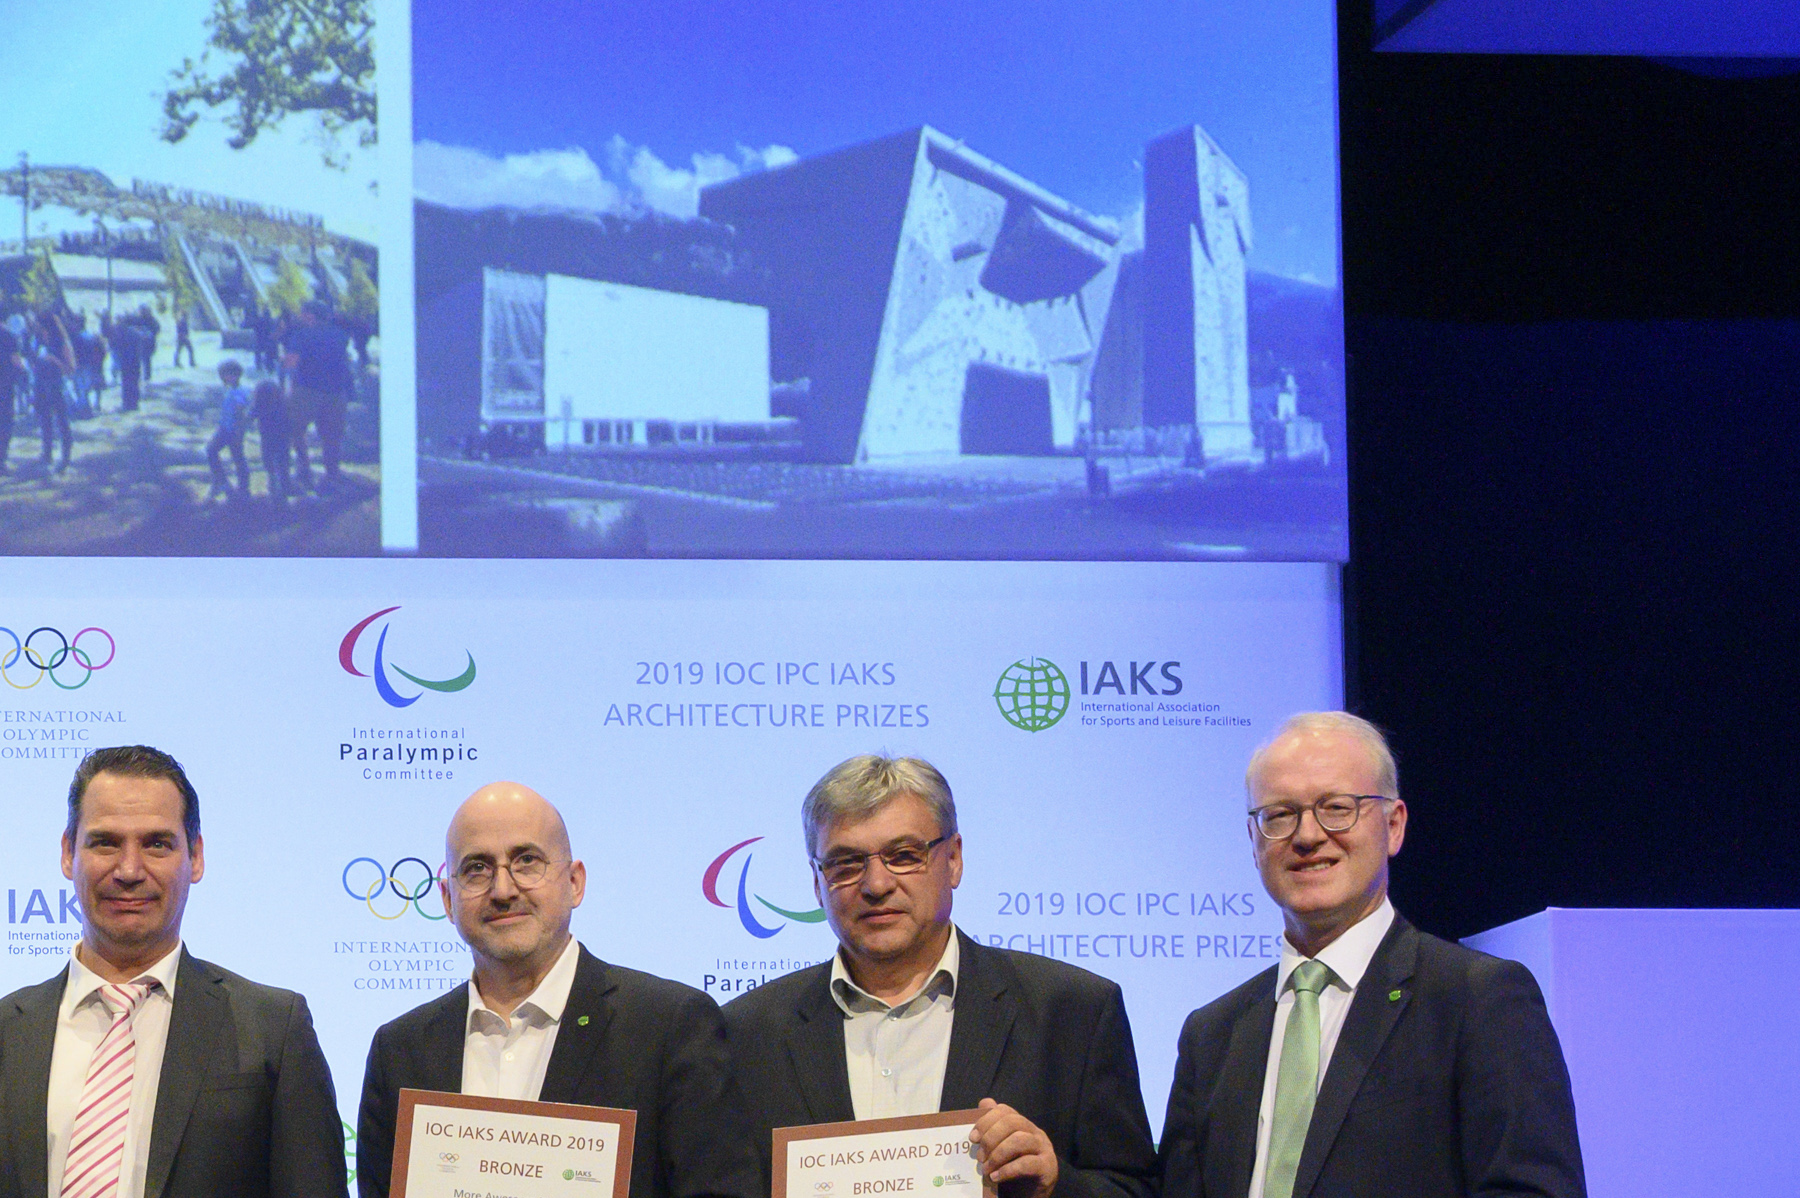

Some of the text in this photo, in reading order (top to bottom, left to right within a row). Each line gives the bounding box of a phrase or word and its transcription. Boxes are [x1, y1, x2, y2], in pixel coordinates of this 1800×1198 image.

[636, 662, 895, 686] 2019 IOC IPC IAKS
[1081, 661, 1183, 696] IAKS
[604, 703, 929, 728] ARCHITECTURE PRIZES
[1081, 702, 1221, 712] International Association
[1081, 715, 1251, 728] for Sports and Leisure Facilities
[3, 729, 89, 740] OLYMPIC
[353, 727, 464, 739] International
[340, 743, 477, 764] Paralympic
[363, 768, 453, 780] Committee
[8, 889, 82, 924] IAK
[998, 892, 1255, 916] 2019 IOC IPC IAKS
[8, 944, 64, 957] for Sports
[334, 942, 468, 953] INTERNATION
[369, 960, 454, 971] OLYMPIC
[425, 1121, 605, 1153] IOC IAKS AWARD 2019
[799, 1140, 970, 1169] IOC IAKS AWARD 2019
[479, 1159, 544, 1179] BRONZE
[853, 1177, 914, 1196] BRONZE
